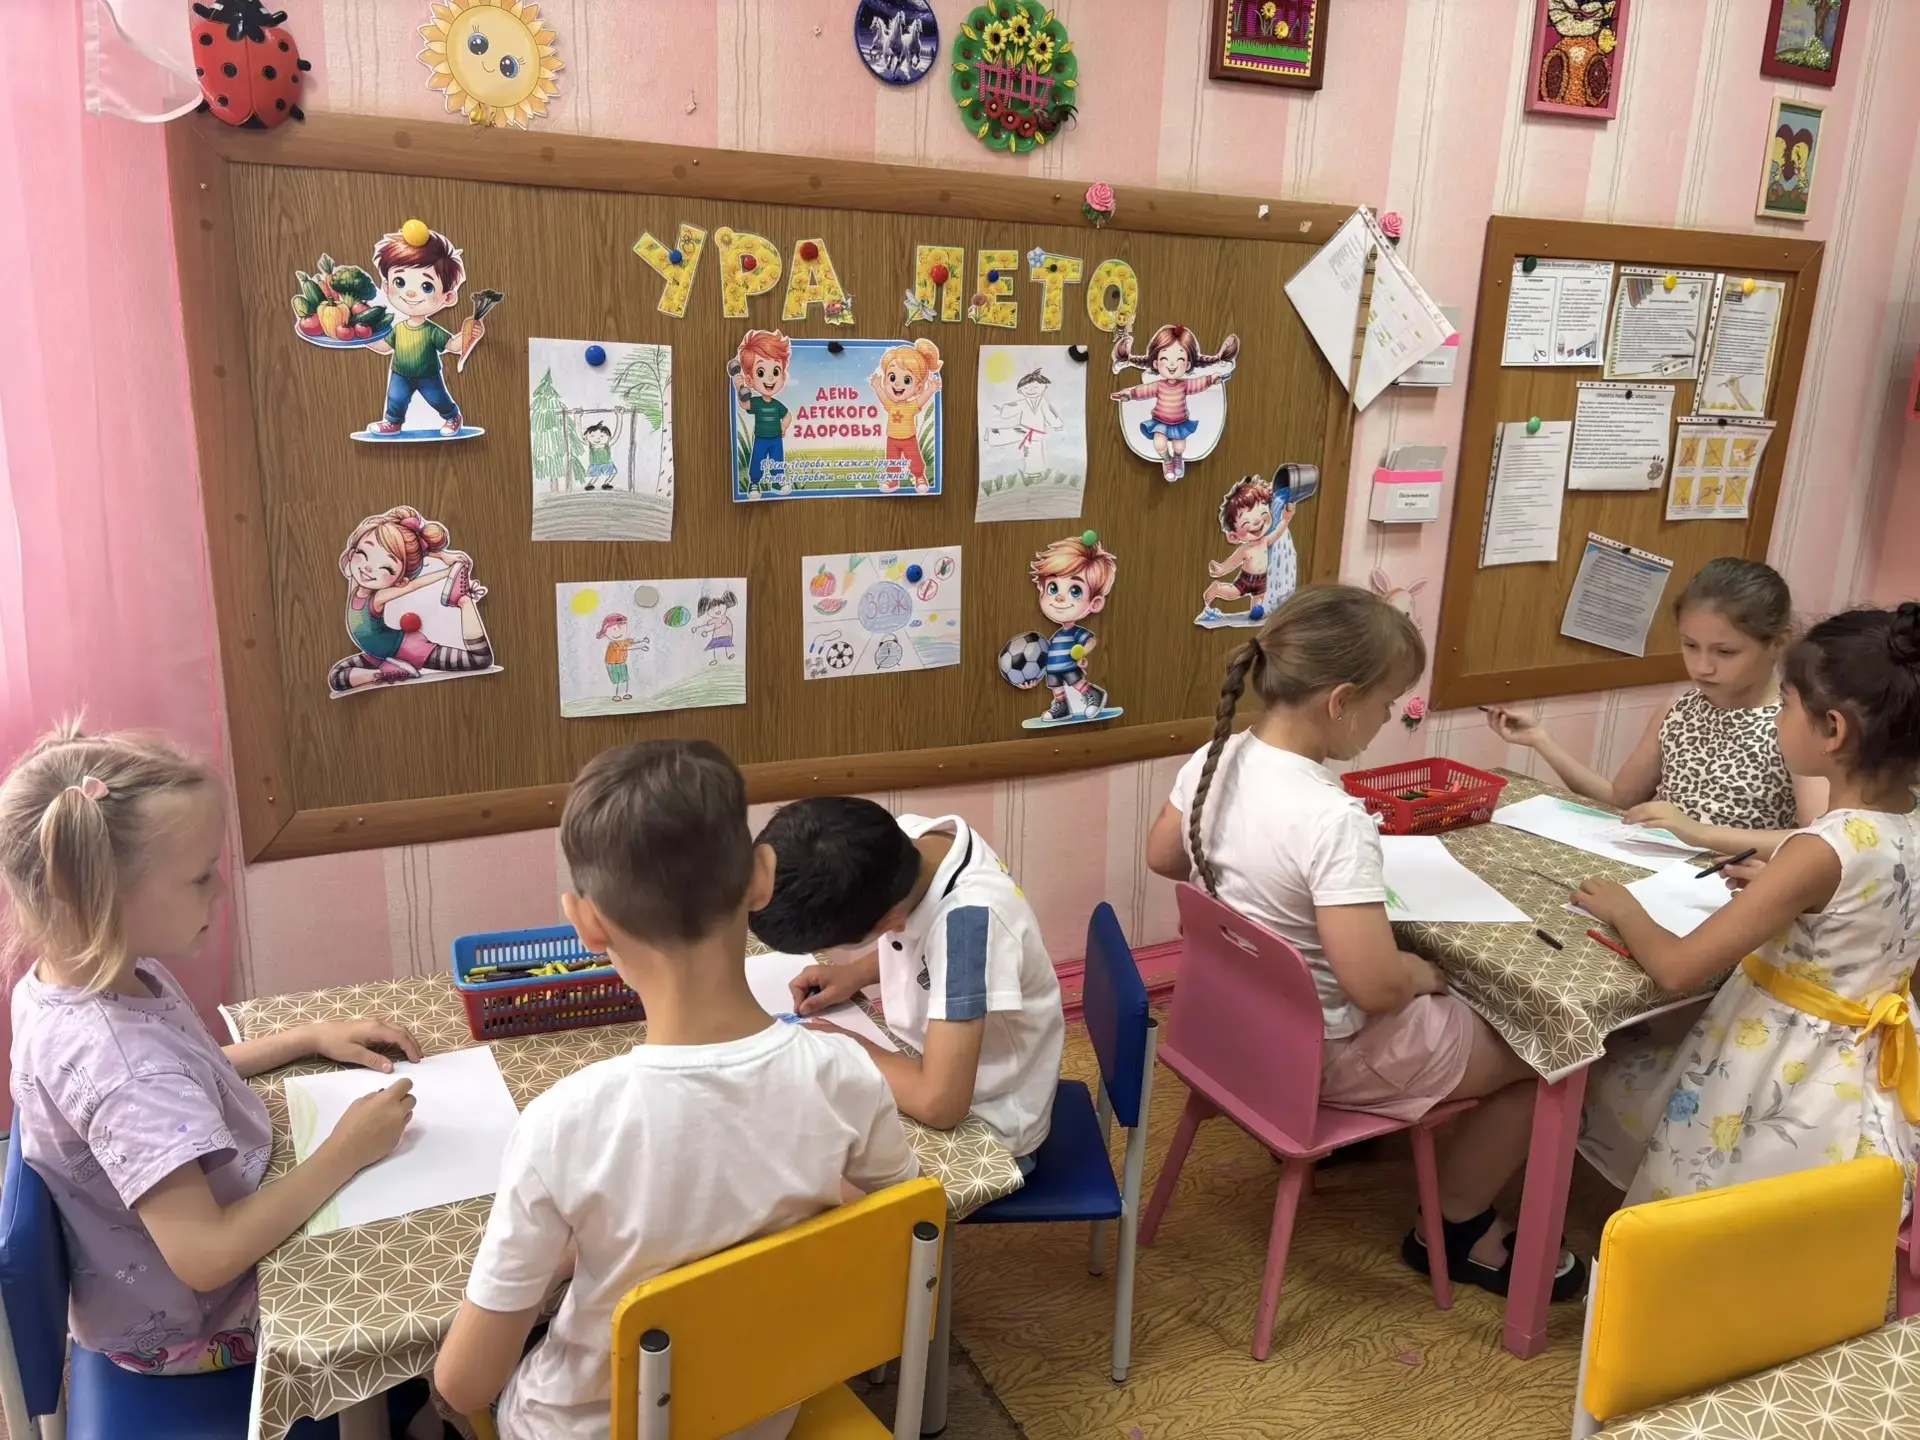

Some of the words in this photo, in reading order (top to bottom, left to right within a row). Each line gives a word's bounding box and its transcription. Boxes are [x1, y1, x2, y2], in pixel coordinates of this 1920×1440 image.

[633, 223, 854, 324] УРА
[906, 245, 1138, 334] ЛЕТО
[816, 386, 859, 401] ДЕНЬ
[796, 405, 878, 420] ДЕТСКОГО
[793, 424, 882, 439] ЗДОРОВЬЯ
[769, 459, 788, 469] день
[790, 458, 830, 472] здоровья
[833, 460, 870, 469] скажем
[764, 473, 786, 482] Быть
[790, 471, 835, 484] здоровым
[846, 473, 872, 481] очень
[864, 590, 908, 620] ЗОЖ
